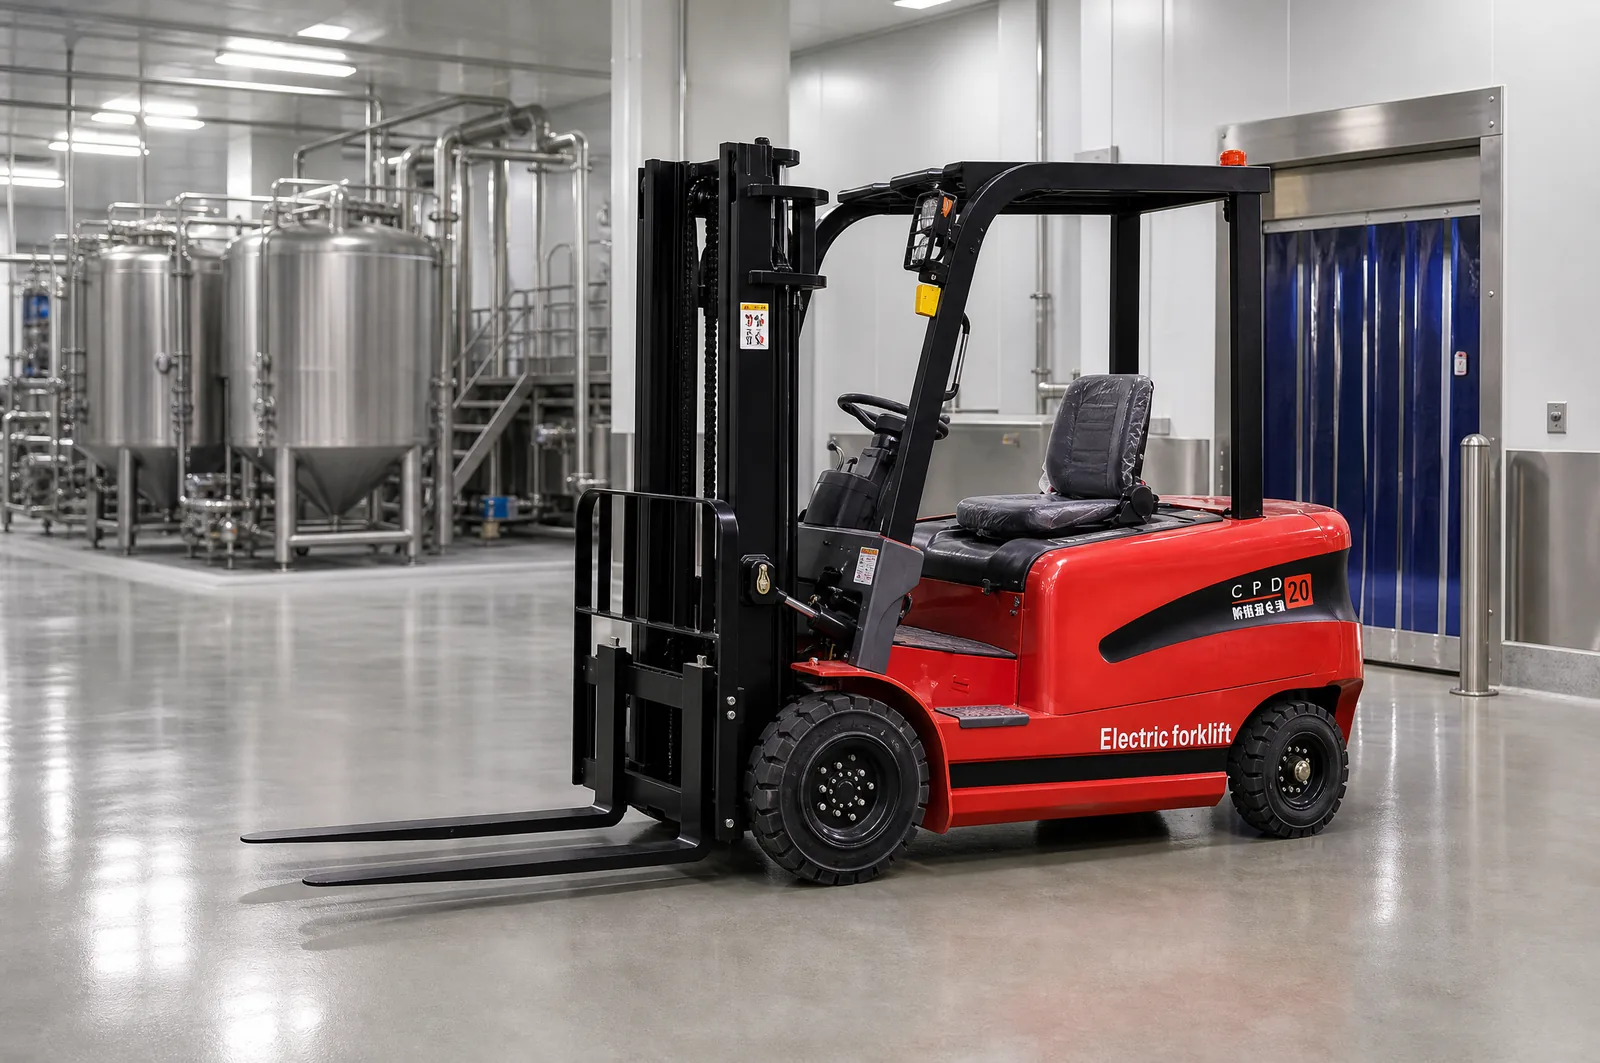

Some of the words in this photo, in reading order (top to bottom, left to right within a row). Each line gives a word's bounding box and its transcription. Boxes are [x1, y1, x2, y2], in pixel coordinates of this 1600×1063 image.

[1287, 579, 1310, 603] 20
[1100, 726, 1169, 750] Electric
[1172, 722, 1232, 746] forklift
